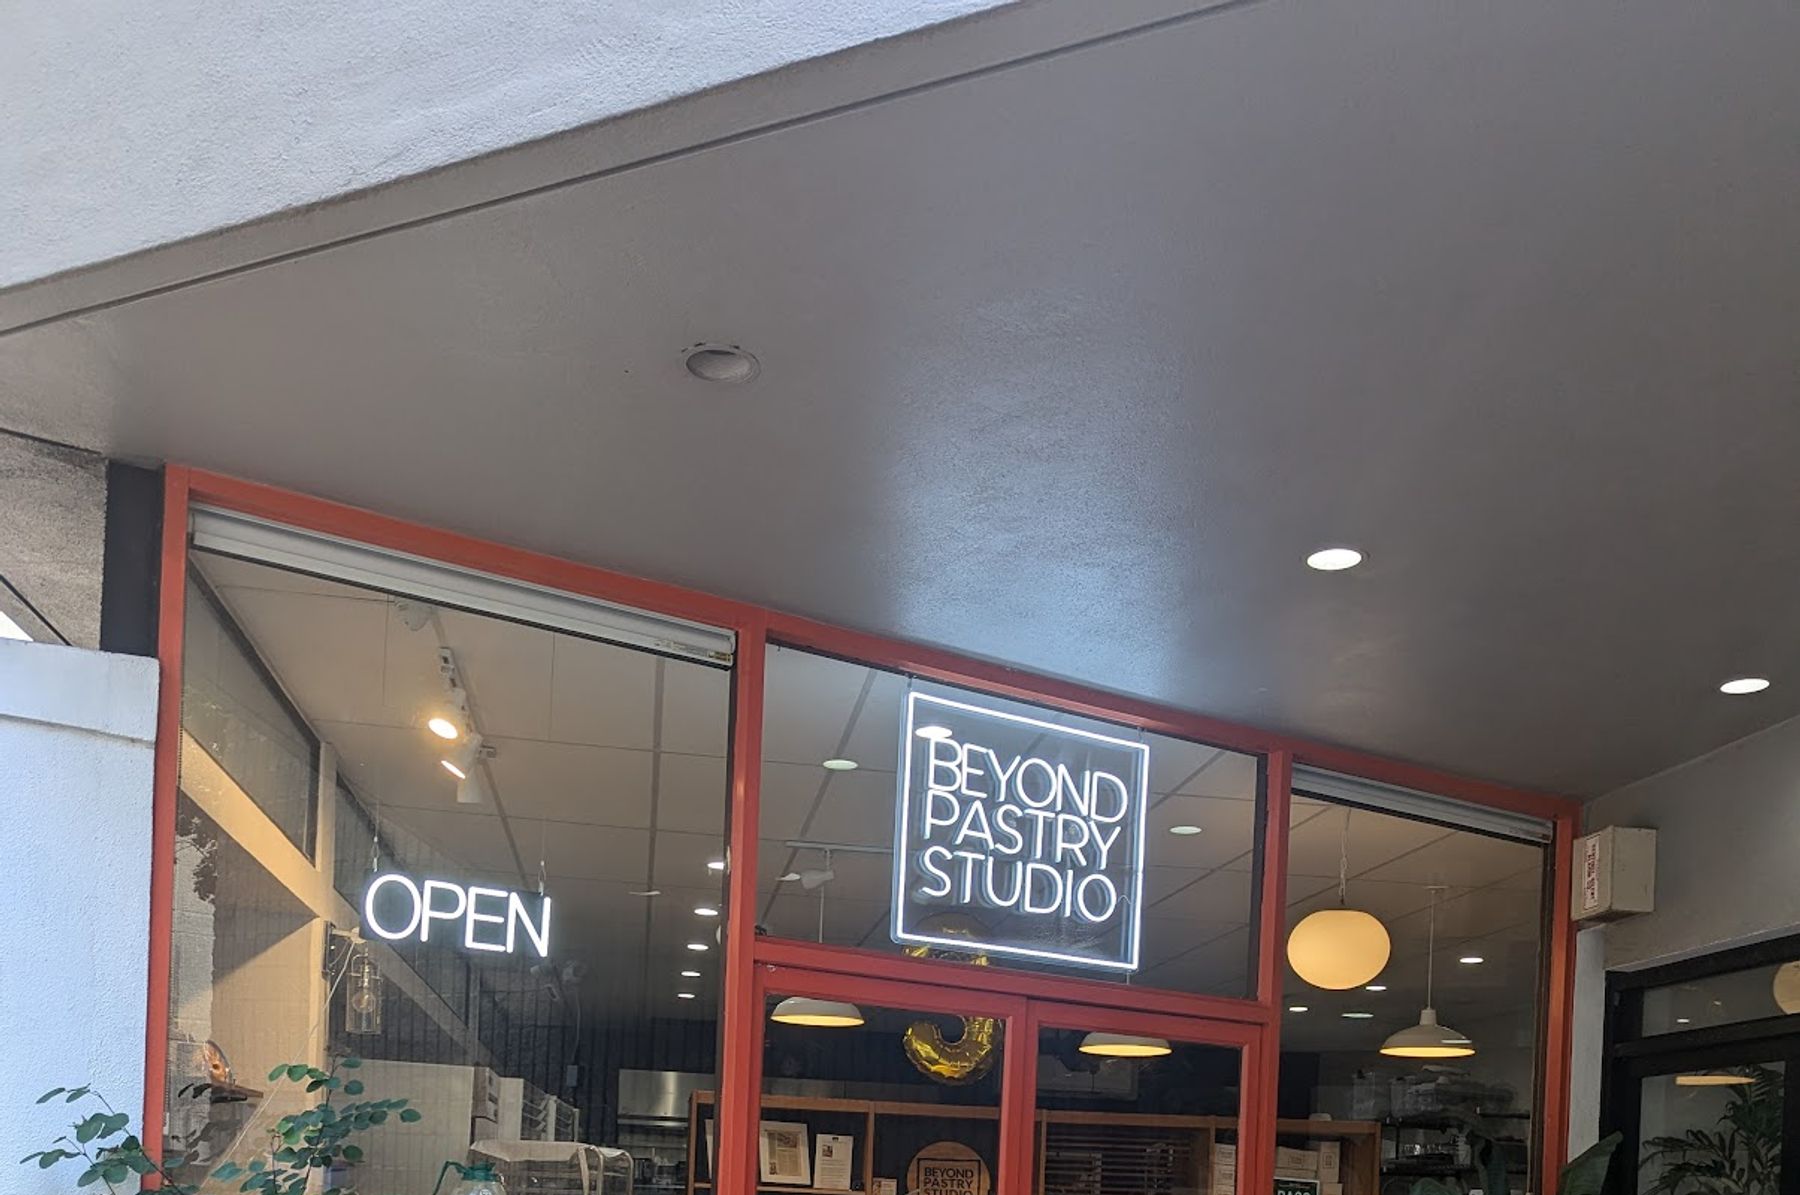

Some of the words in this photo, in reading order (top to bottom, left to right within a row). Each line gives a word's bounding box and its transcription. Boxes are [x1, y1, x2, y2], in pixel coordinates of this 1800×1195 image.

[927, 736, 1128, 823] BEYOND
[923, 789, 1122, 871] PASTRY
[365, 873, 552, 958] OPEN
[919, 845, 1117, 922] STUDIO
[923, 1177, 973, 1189] PASTRY
[924, 1167, 974, 1179] BEYOND
